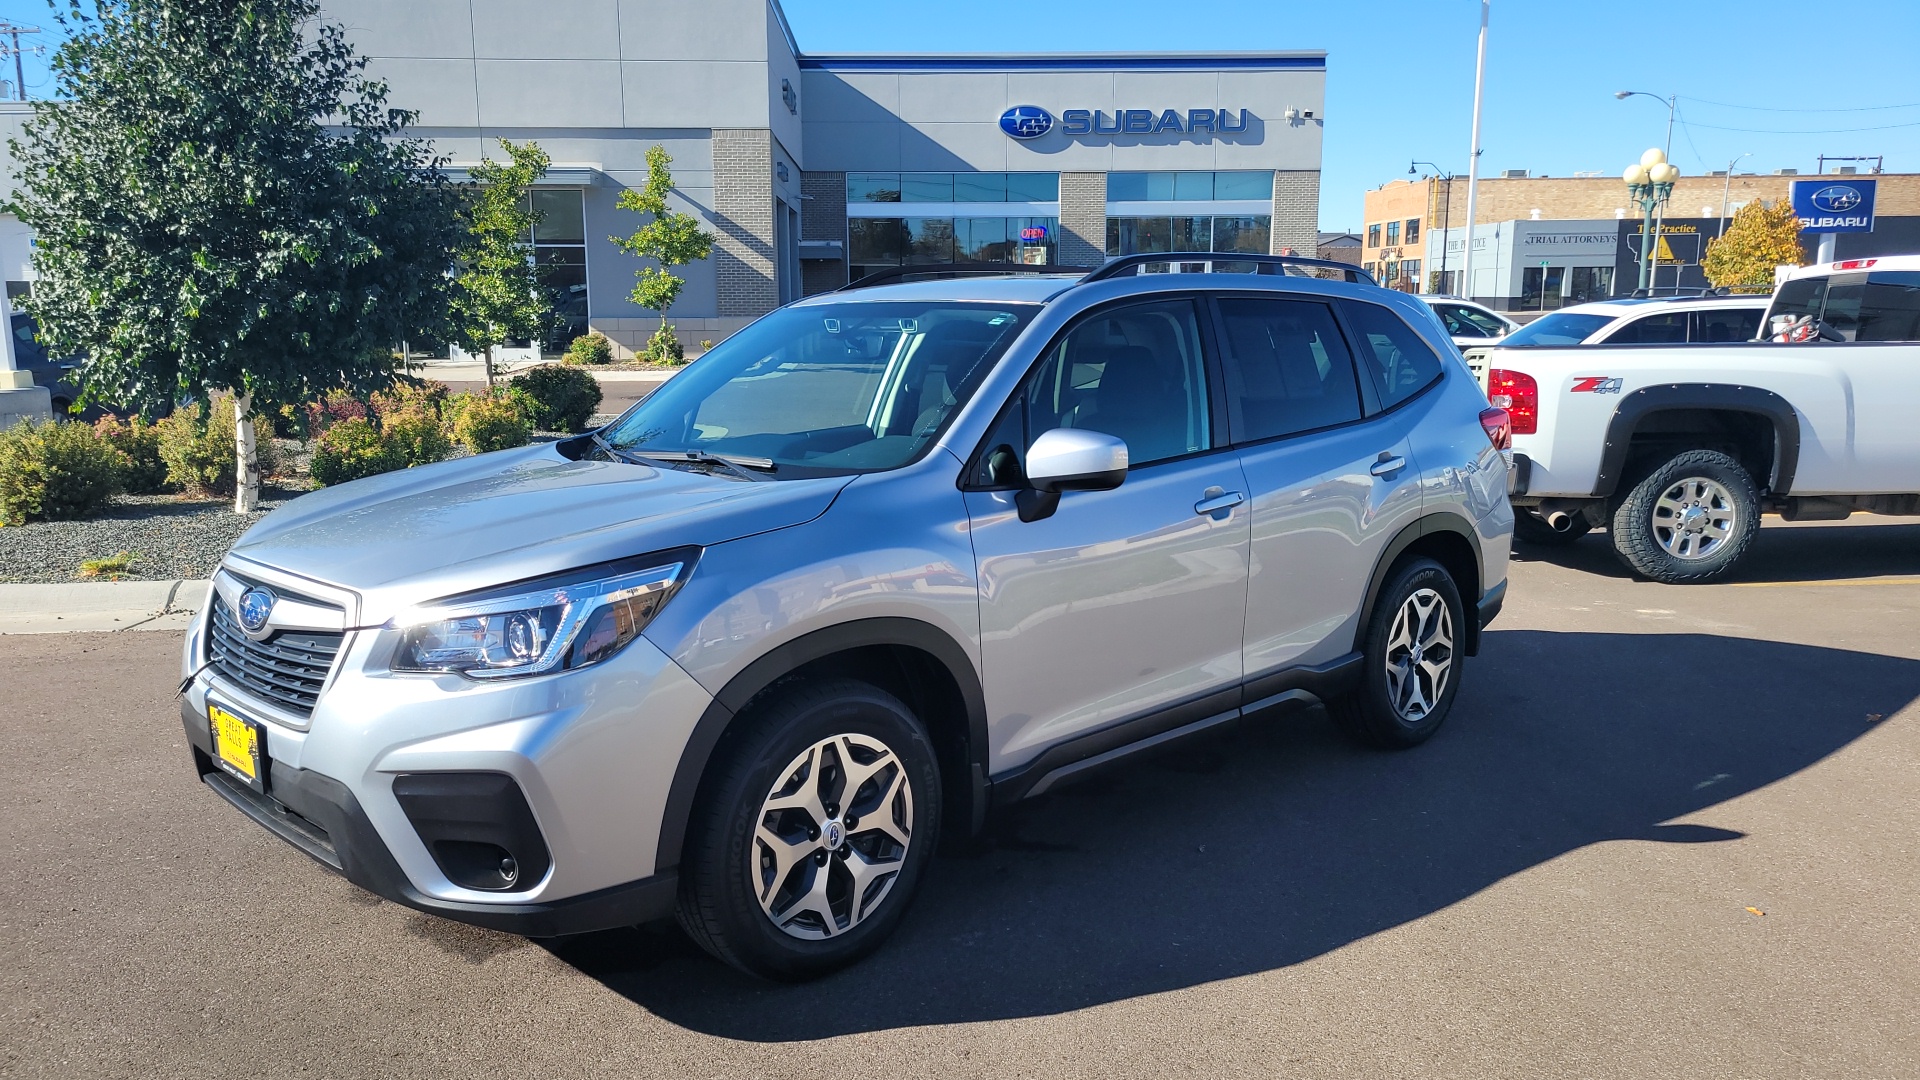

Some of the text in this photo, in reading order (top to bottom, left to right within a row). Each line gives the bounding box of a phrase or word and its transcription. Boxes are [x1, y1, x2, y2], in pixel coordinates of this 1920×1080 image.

[1062, 109, 1248, 135] SUBARU
[1637, 223, 1697, 233] Te Practice
[1798, 217, 1868, 228] SUBARU
[1021, 228, 1045, 239] OPEN
[1529, 235, 1617, 244] TRIAL ATTORNEYS
[1448, 240, 1459, 251] THE
[1570, 376, 1624, 392] Z71
[225, 717, 242, 736] GREAT
[225, 729, 242, 749] FALLS
